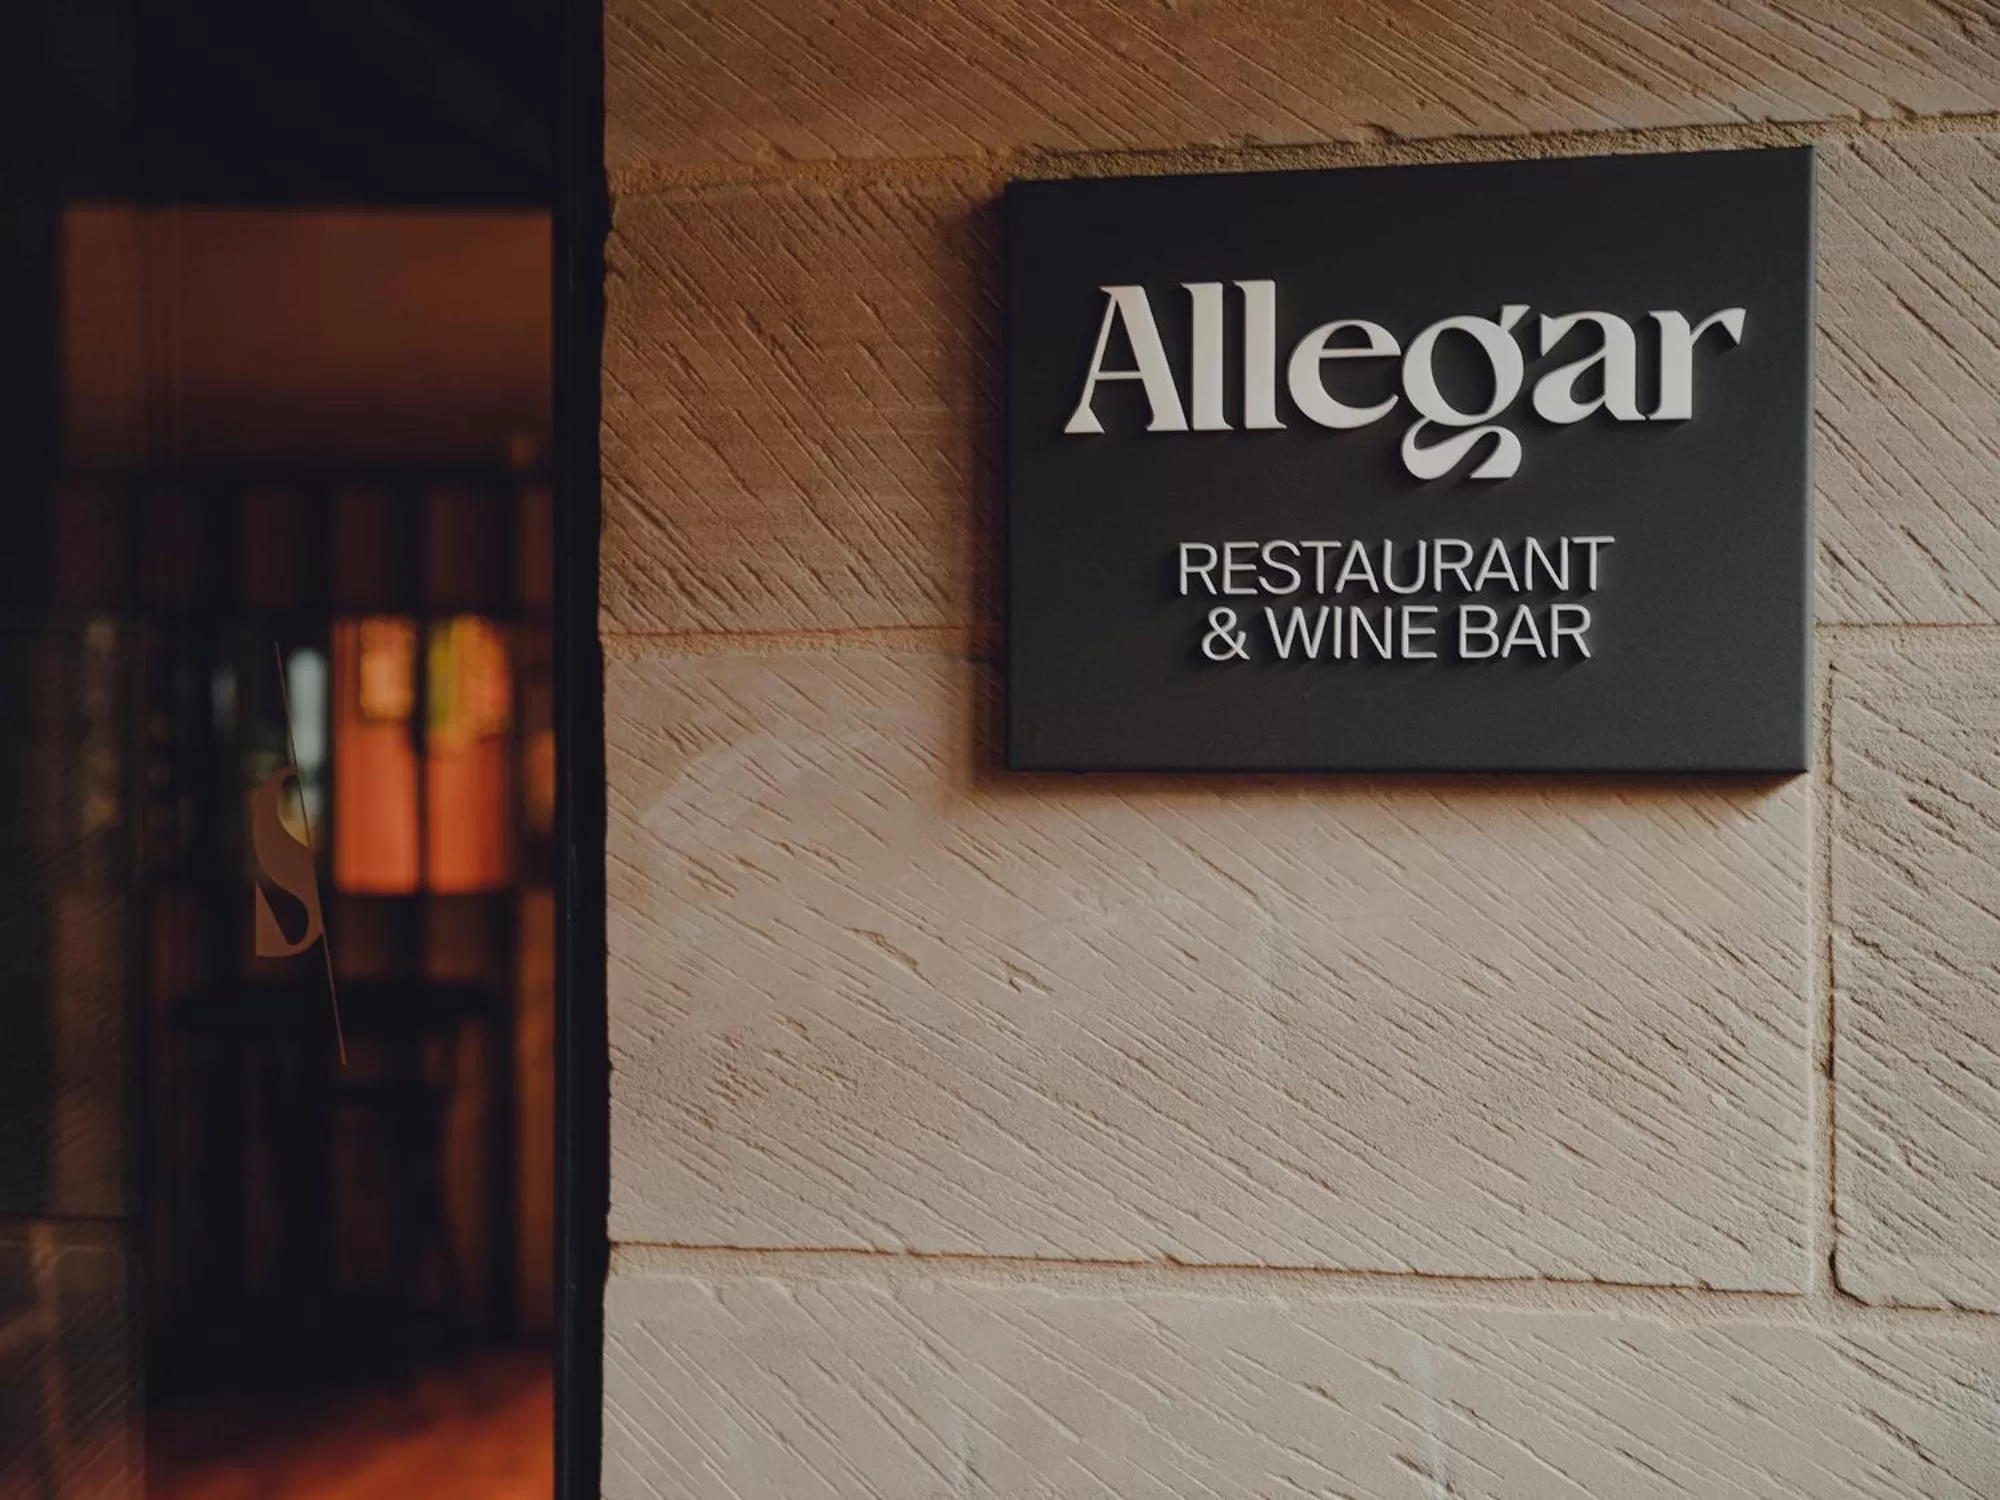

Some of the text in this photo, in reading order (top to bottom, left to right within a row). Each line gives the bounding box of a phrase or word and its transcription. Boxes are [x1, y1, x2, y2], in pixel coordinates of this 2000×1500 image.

[1064, 279, 1746, 480] Allegar
[1179, 534, 1615, 596] RESTAURANT
[1201, 603, 1593, 662] & WINE BAR
